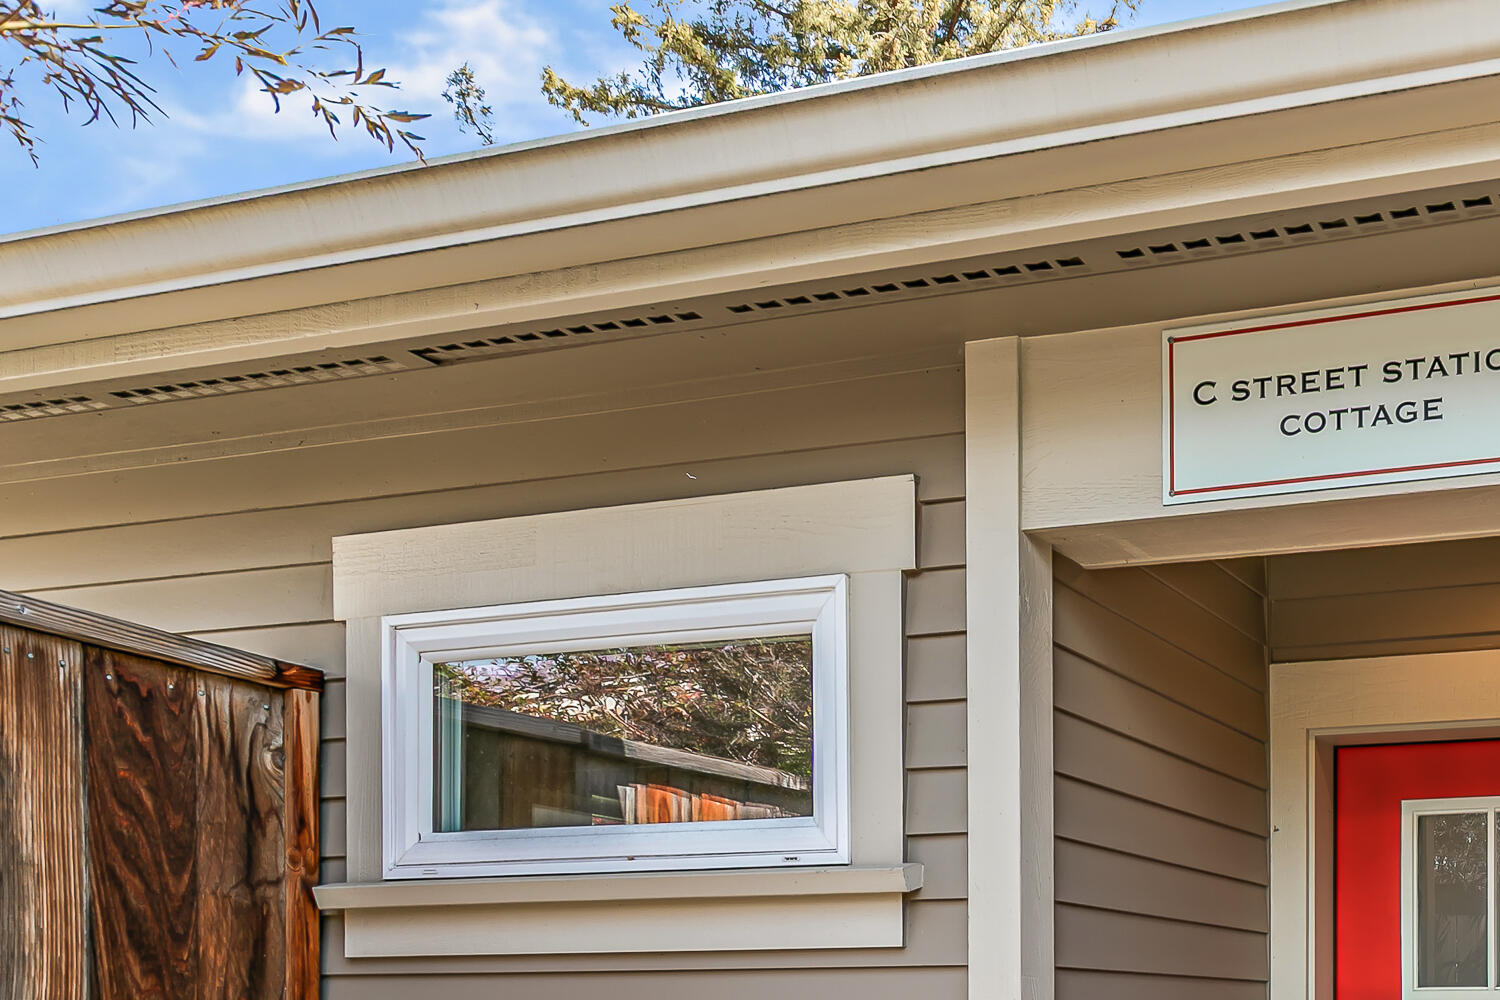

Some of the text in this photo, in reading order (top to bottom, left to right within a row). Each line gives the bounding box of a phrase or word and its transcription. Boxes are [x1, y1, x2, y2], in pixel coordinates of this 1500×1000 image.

[1192, 380, 1218, 406] C
[1231, 363, 1369, 402] STREET
[1279, 396, 1444, 437] COTTAGE
